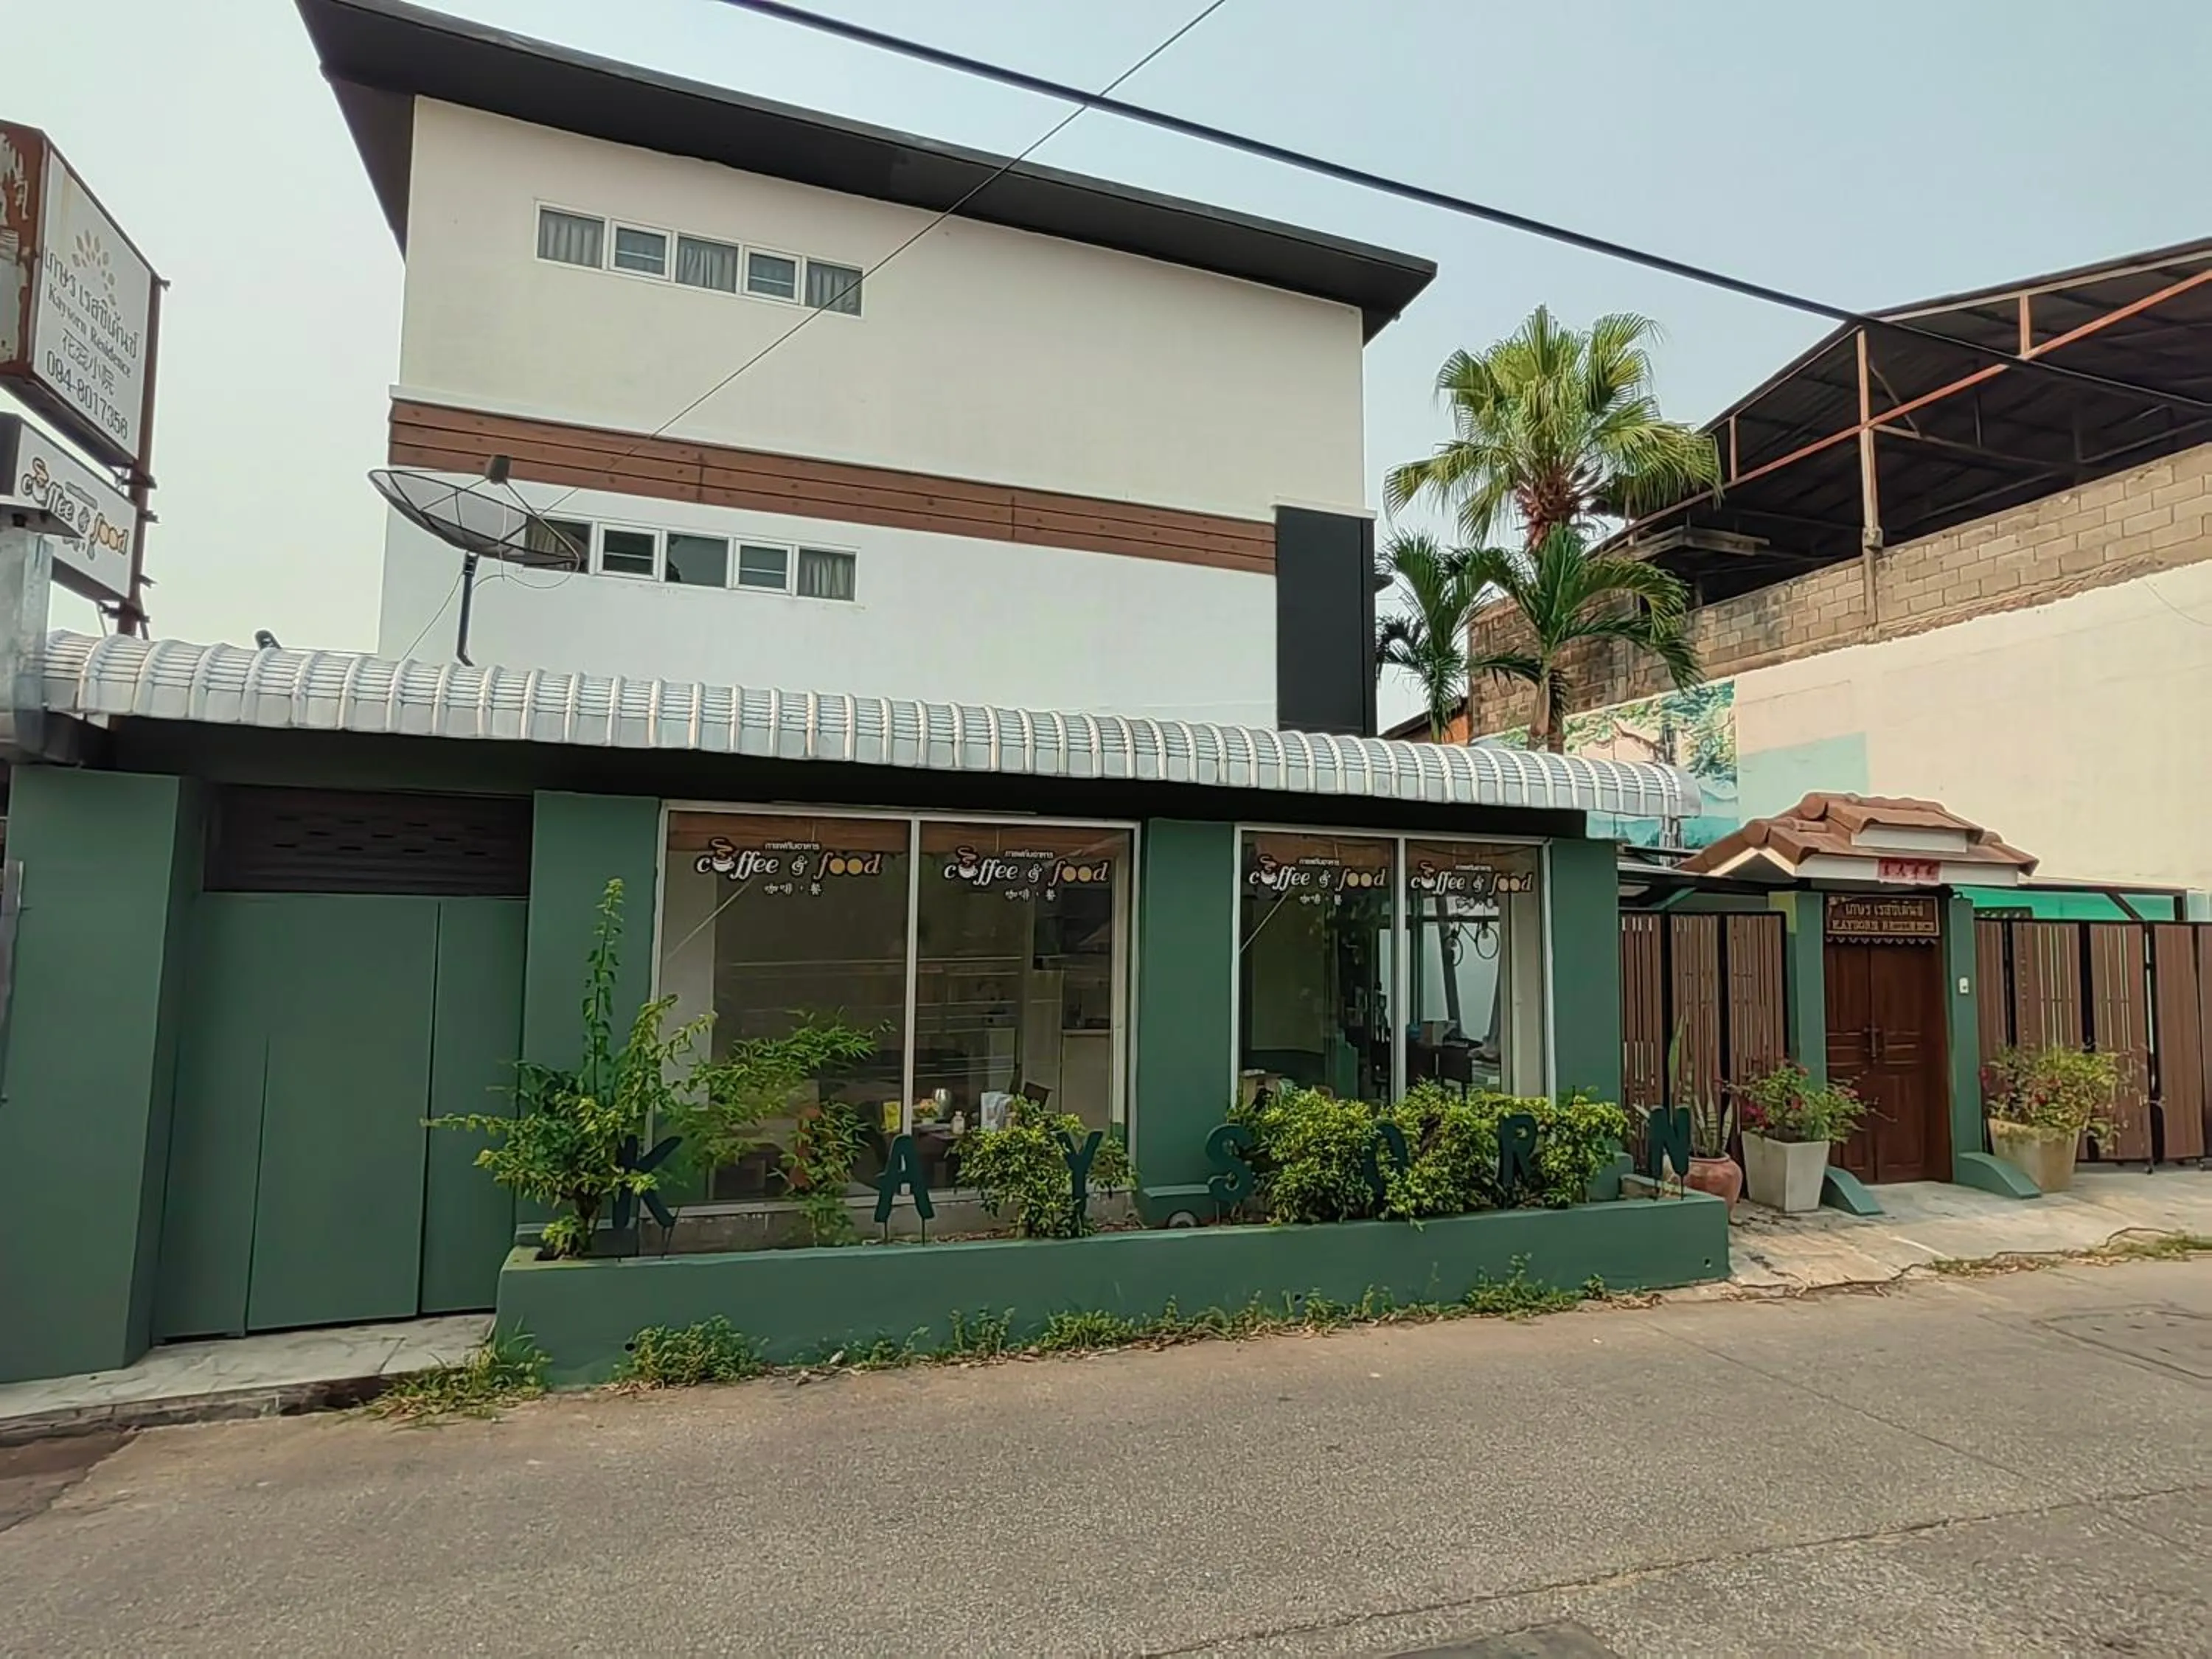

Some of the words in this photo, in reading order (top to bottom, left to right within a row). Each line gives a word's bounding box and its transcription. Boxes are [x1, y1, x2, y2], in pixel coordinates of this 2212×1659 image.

[48, 282, 87, 335] Kaysorn
[89, 512, 129, 555] food
[697, 846, 779, 880] coffee
[790, 855, 808, 876] &
[813, 851, 883, 880] food
[944, 854, 1019, 886] coffee
[1027, 863, 1043, 883] &
[1048, 860, 1107, 887] food
[1249, 861, 1310, 891] coffee
[1319, 869, 1331, 888] &
[1335, 868, 1386, 891] food
[1411, 867, 1466, 895] coffee
[1472, 875, 1484, 893] &
[1488, 872, 1533, 896] food
